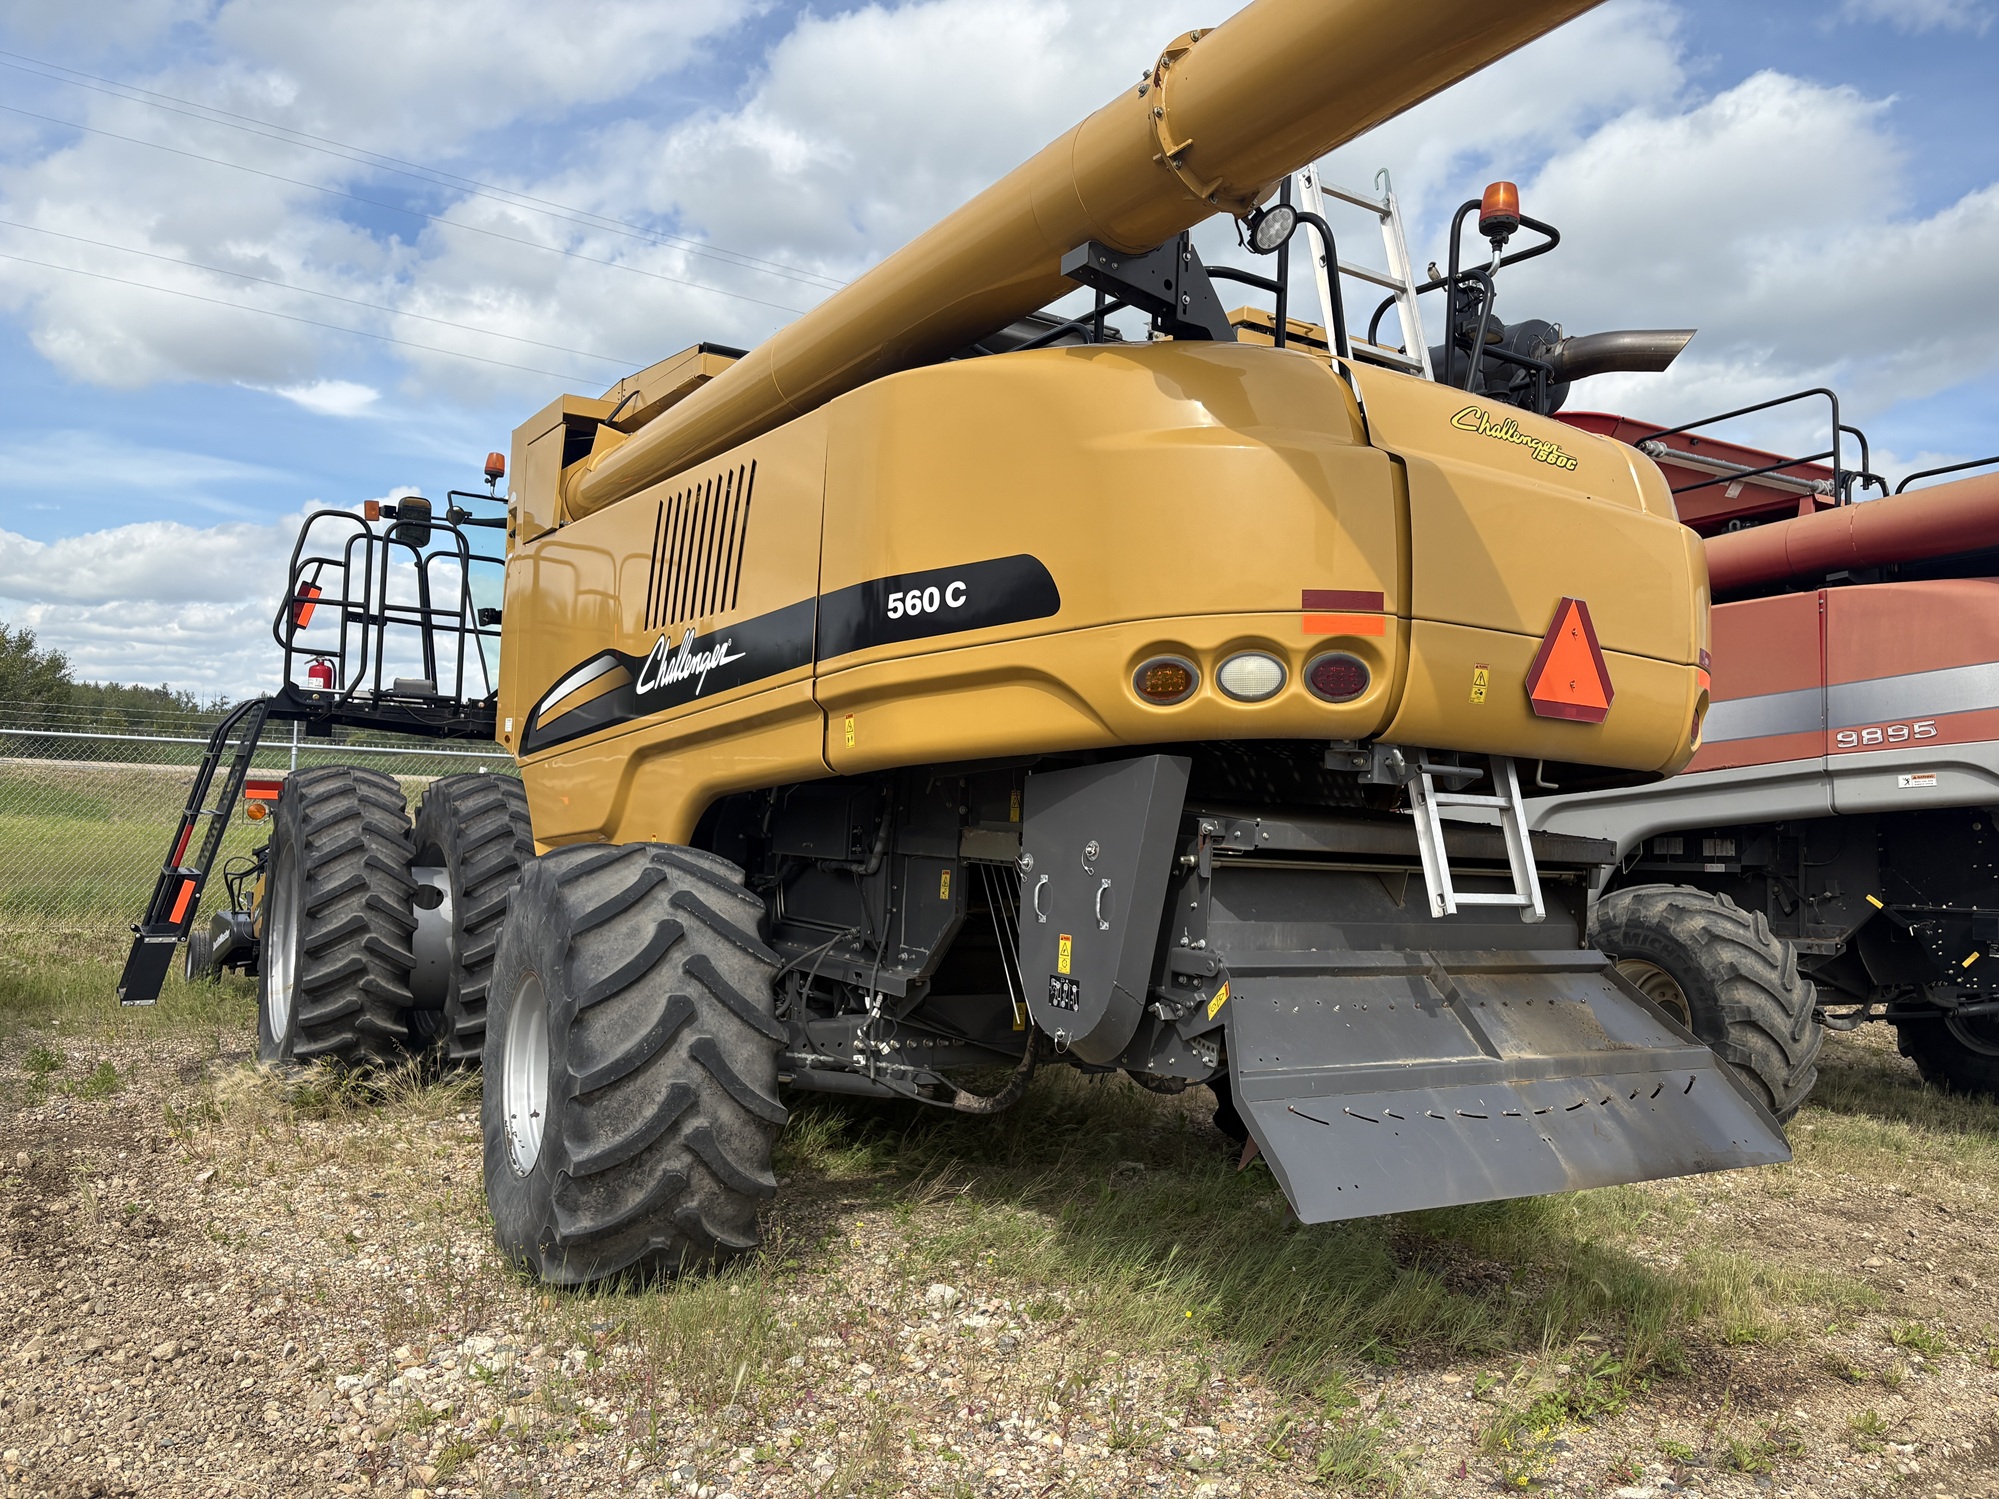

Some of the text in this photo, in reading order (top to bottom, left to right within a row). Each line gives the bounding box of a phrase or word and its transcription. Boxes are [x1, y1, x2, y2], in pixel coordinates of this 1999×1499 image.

[1450, 406, 1577, 459] Challenger
[1536, 449, 1578, 471] 560C
[887, 581, 967, 619] 560 C
[636, 628, 746, 695] Challenger
[1836, 719, 1938, 748] 9895
